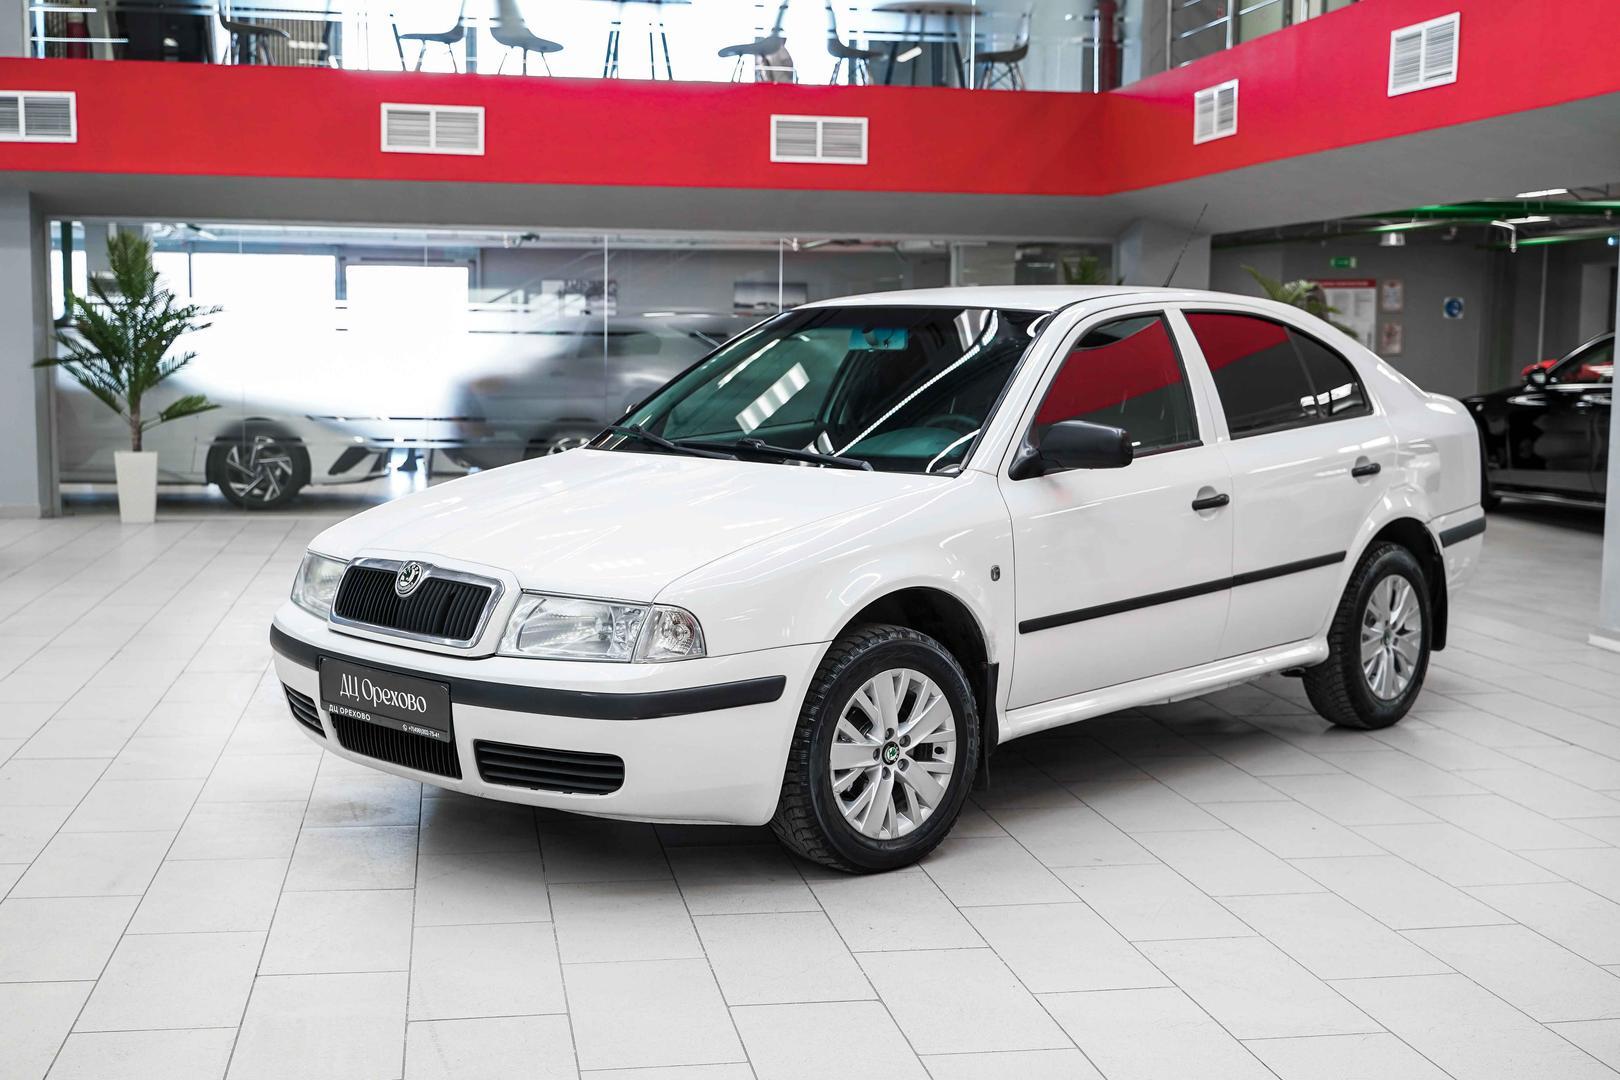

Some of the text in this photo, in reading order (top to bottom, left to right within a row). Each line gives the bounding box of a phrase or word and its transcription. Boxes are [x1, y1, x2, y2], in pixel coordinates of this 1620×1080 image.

[340, 673, 427, 713] ДЦ Орехово
[328, 704, 370, 720] ДЦ ОРЕХОВО
